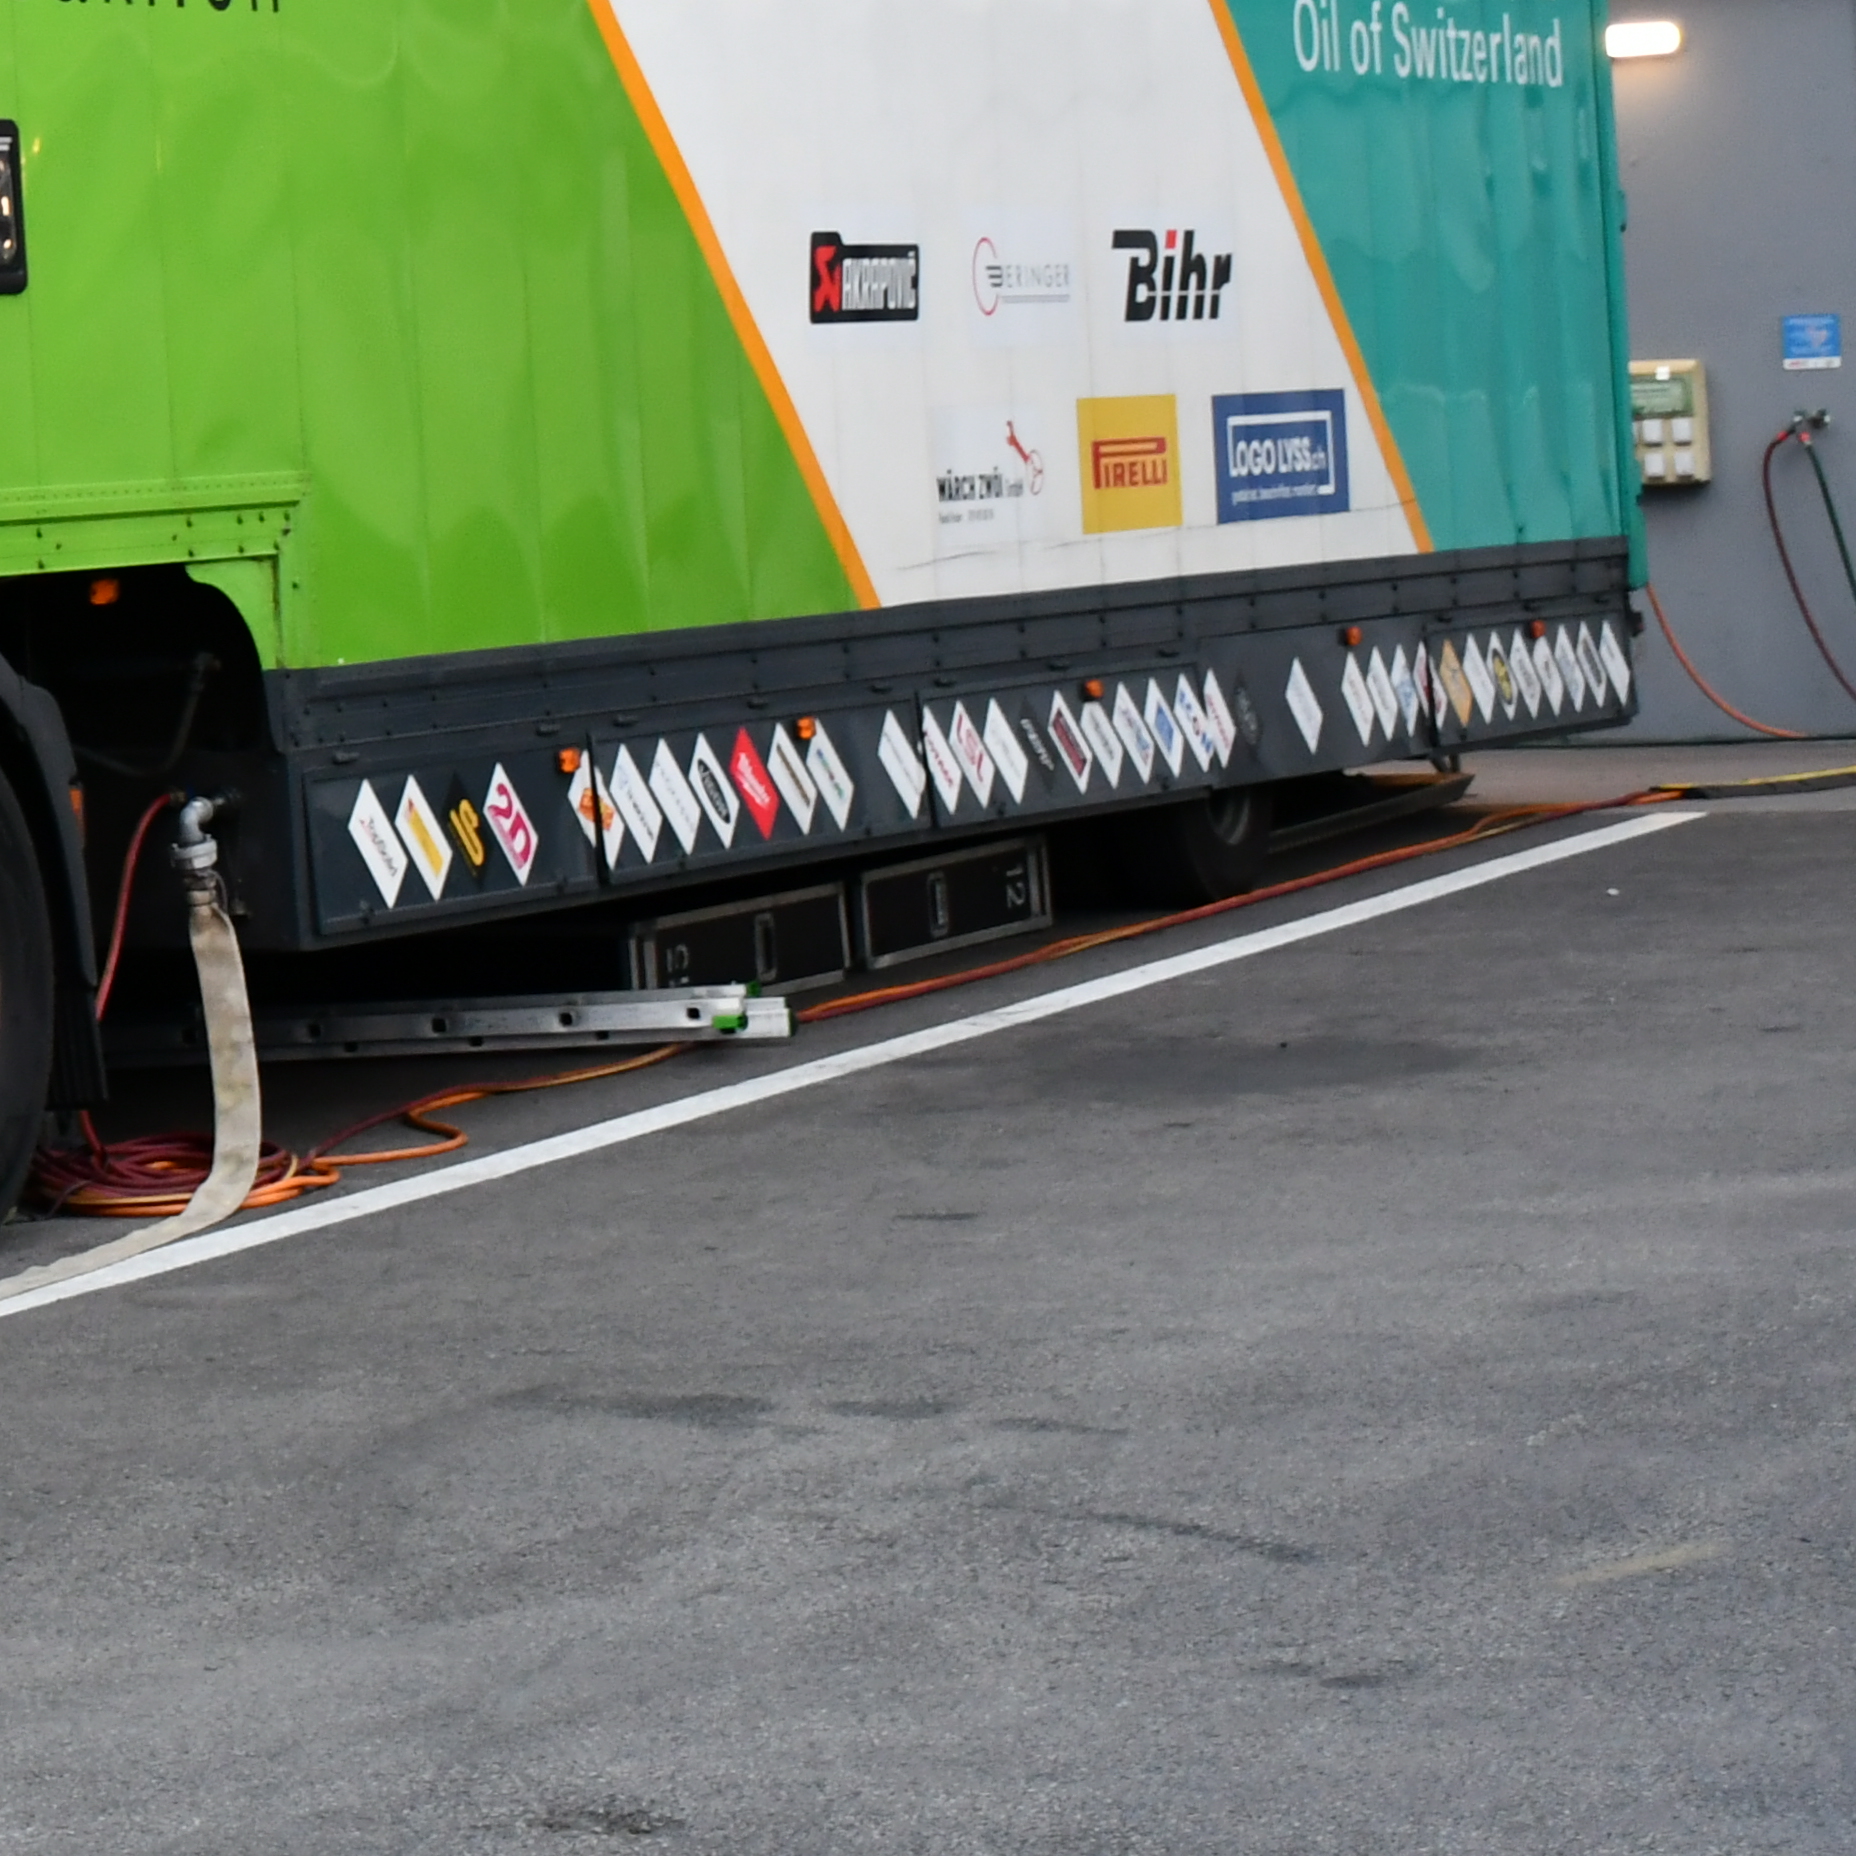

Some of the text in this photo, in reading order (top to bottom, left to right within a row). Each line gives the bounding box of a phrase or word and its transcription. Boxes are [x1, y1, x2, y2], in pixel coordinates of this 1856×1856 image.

[1350, 0, 1382, 76] of
[1392, 1, 1563, 88] Switzerland
[1111, 228, 1232, 322] Bihr
[1091, 437, 1168, 490] PIRELLI
[1228, 438, 1277, 477] LOGO
